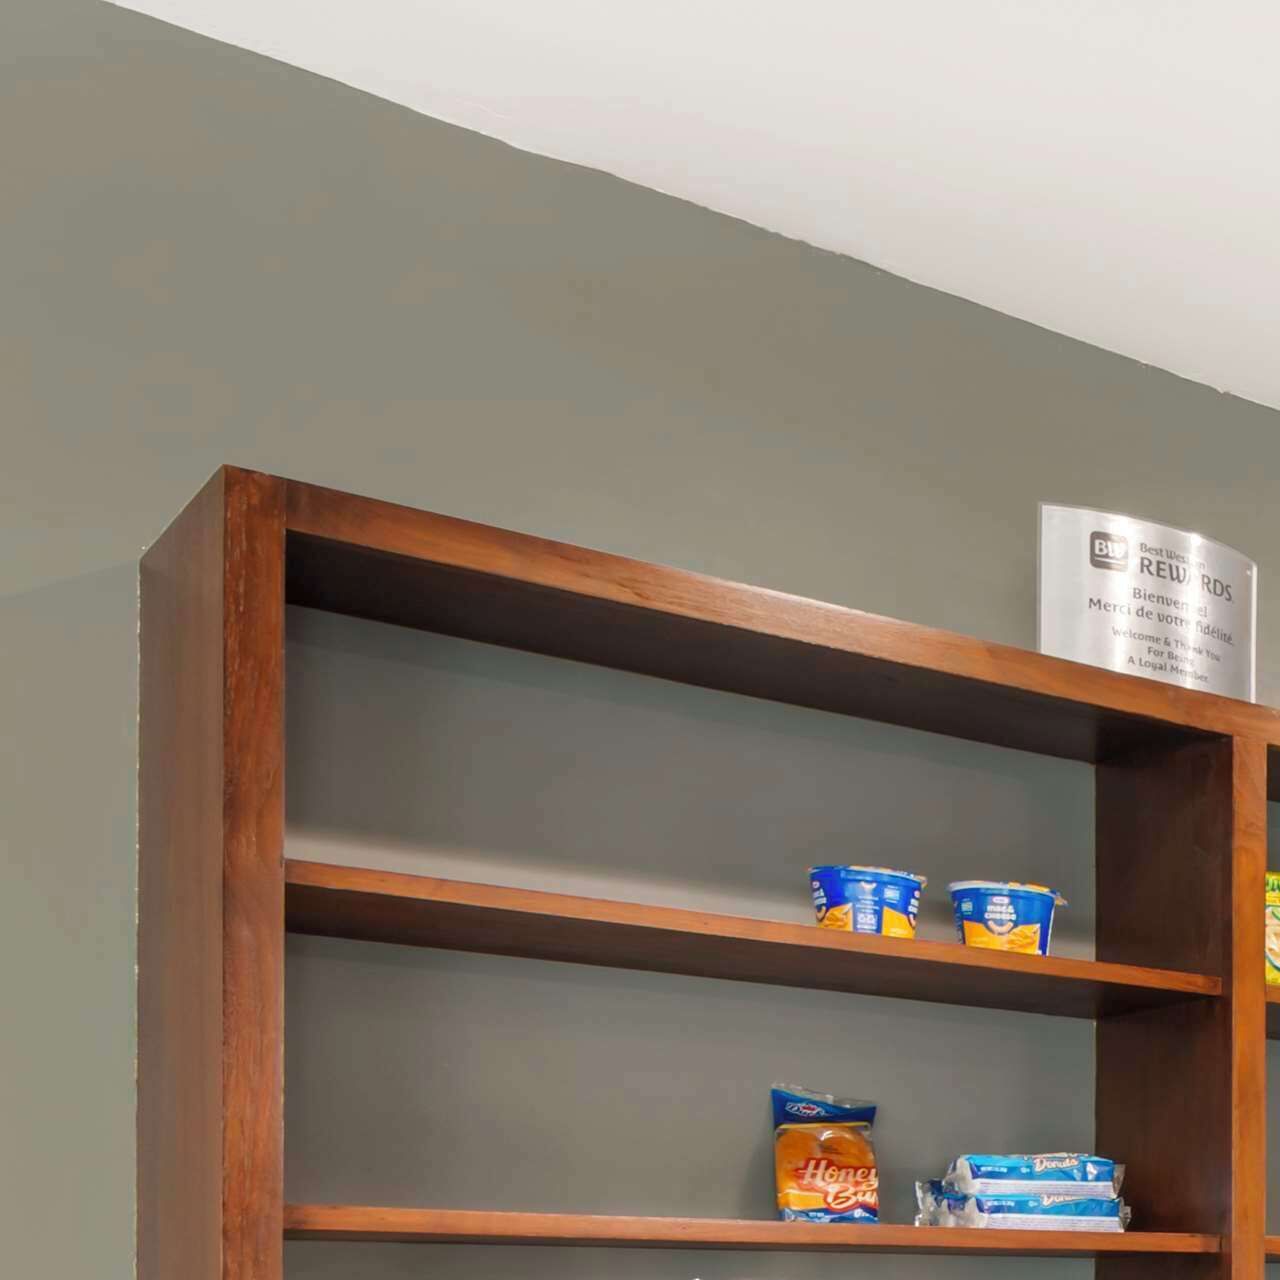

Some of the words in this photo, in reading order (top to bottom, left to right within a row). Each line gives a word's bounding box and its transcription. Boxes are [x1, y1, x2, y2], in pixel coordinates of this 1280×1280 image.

[1094, 539, 1125, 558] BW
[1140, 543, 1164, 559] Best
[1140, 557, 1233, 602] REWRDS
[1088, 598, 1131, 616] Merci
[1136, 606, 1153, 621] de
[1112, 626, 1161, 644] Welcome
[1163, 637, 1171, 647] &
[1173, 639, 1203, 654] Thnk
[1147, 647, 1164, 658] For
[1128, 656, 1136, 665] A
[1140, 658, 1167, 672] Loyal
[798, 1159, 878, 1192] Honey
